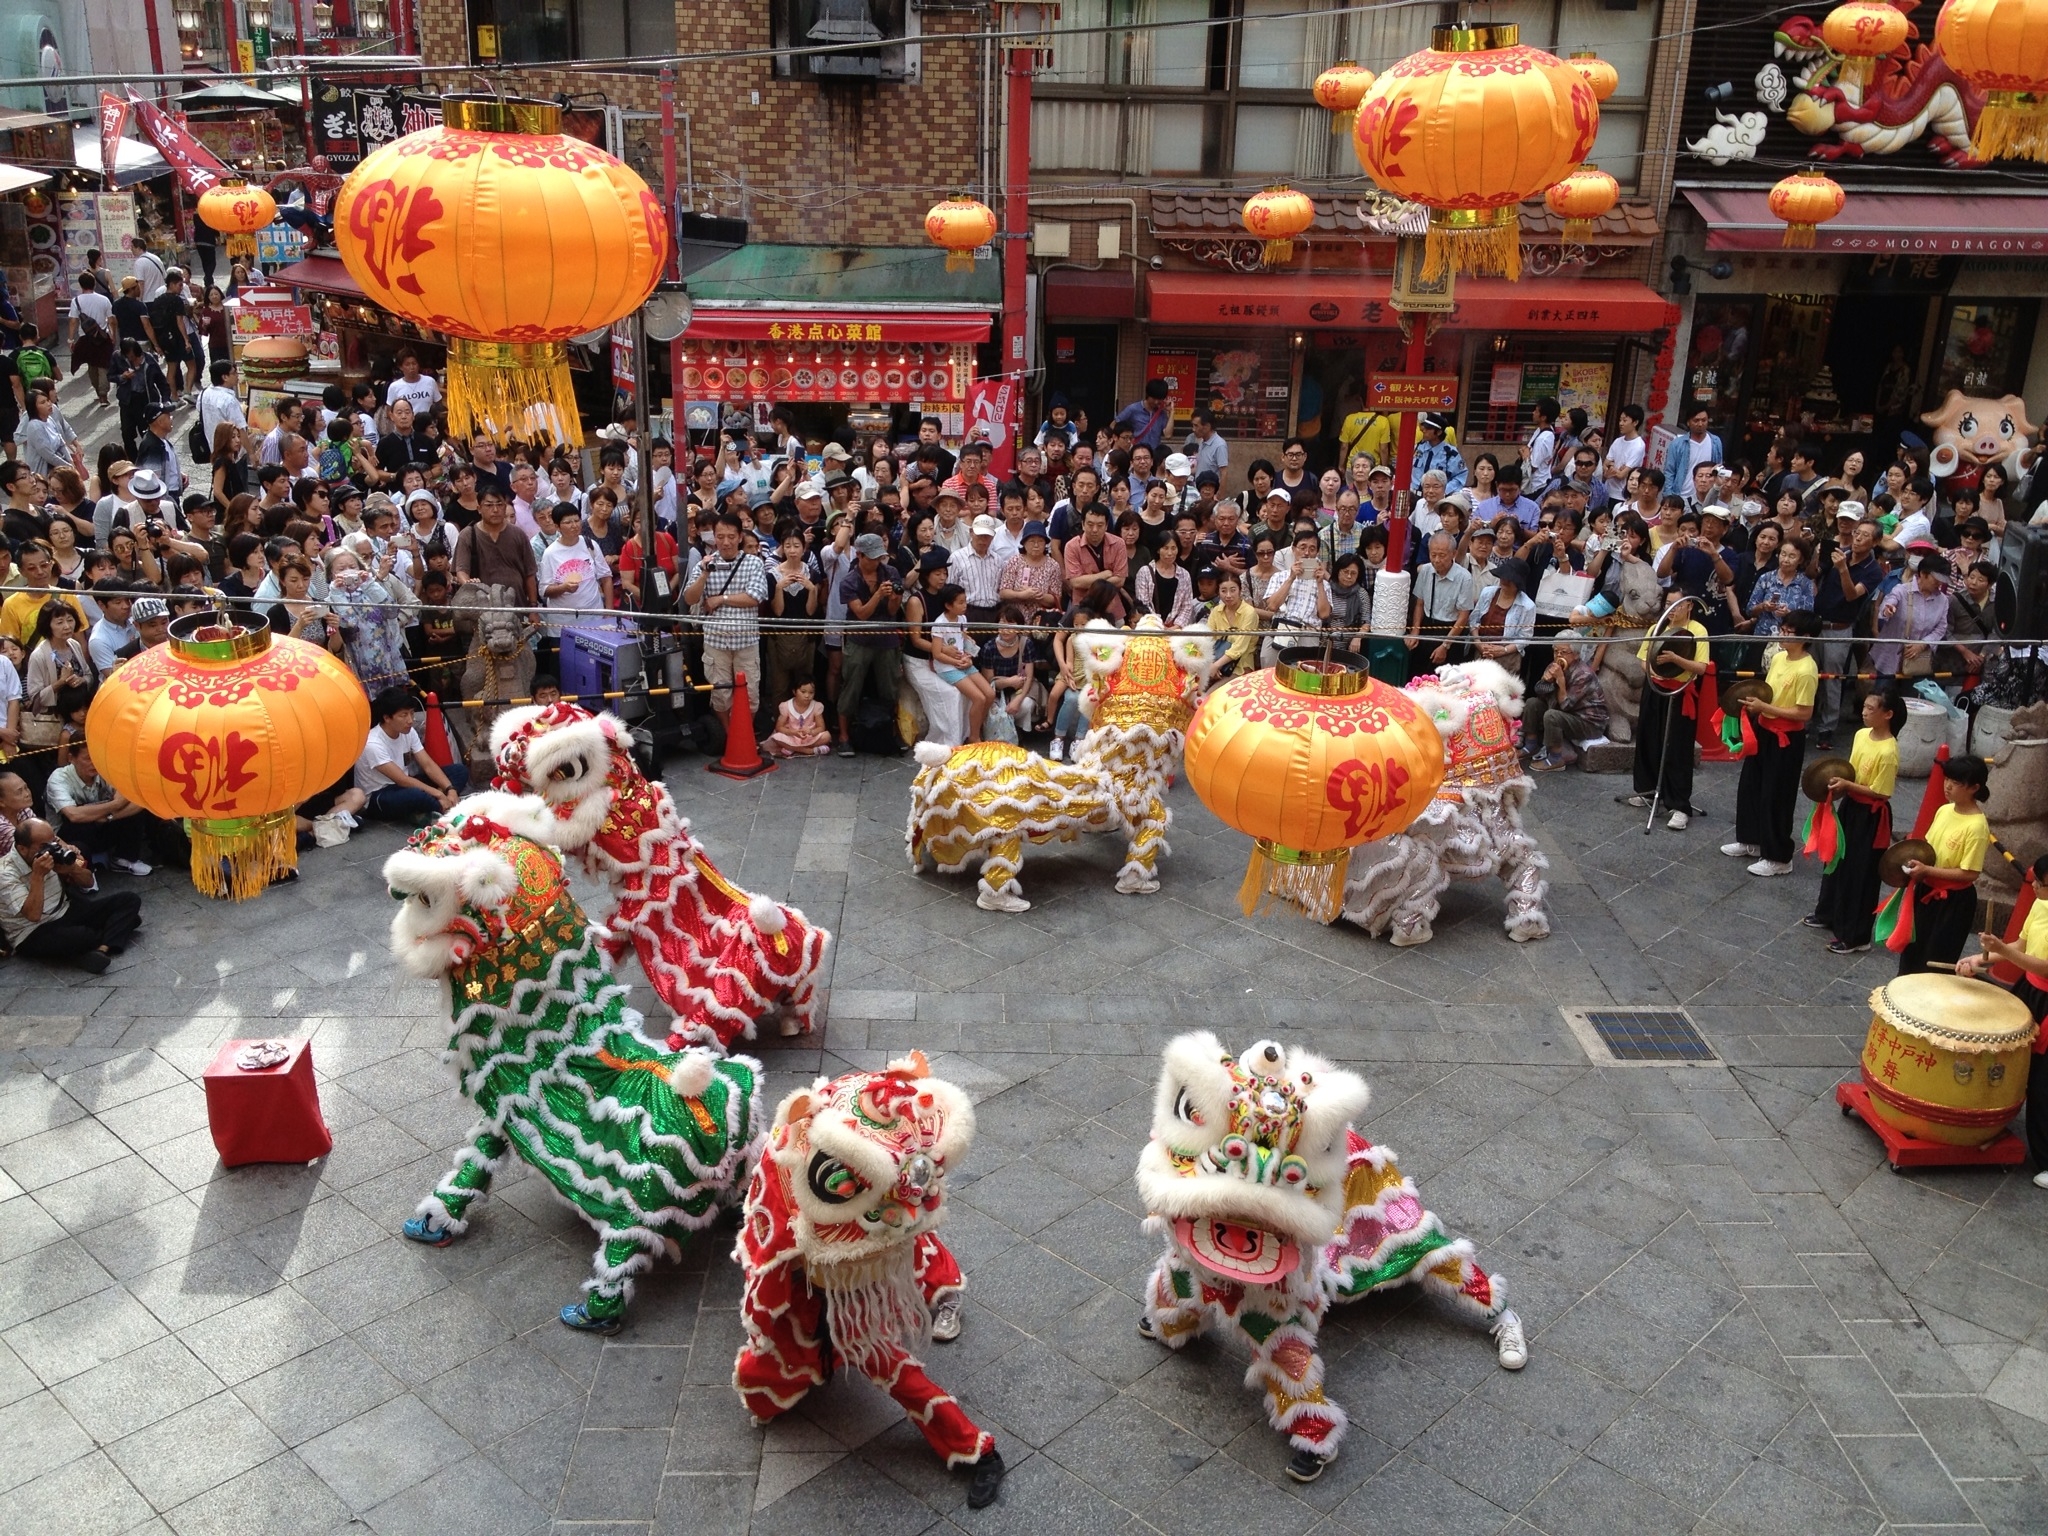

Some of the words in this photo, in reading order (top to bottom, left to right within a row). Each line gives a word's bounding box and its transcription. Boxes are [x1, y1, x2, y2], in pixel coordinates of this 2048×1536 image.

[1886, 239, 1937, 248] MOON
[1951, 239, 2025, 249] DRAGON
[260, 308, 296, 321] 神戸牛
[1528, 309, 1600, 321] 創業大正四年
[767, 323, 882, 340] 香港点心菜館
[1577, 367, 1599, 376] KOBE
[1389, 383, 1449, 392] 観光トイレ
[922, 404, 965, 412] お持ち帰
